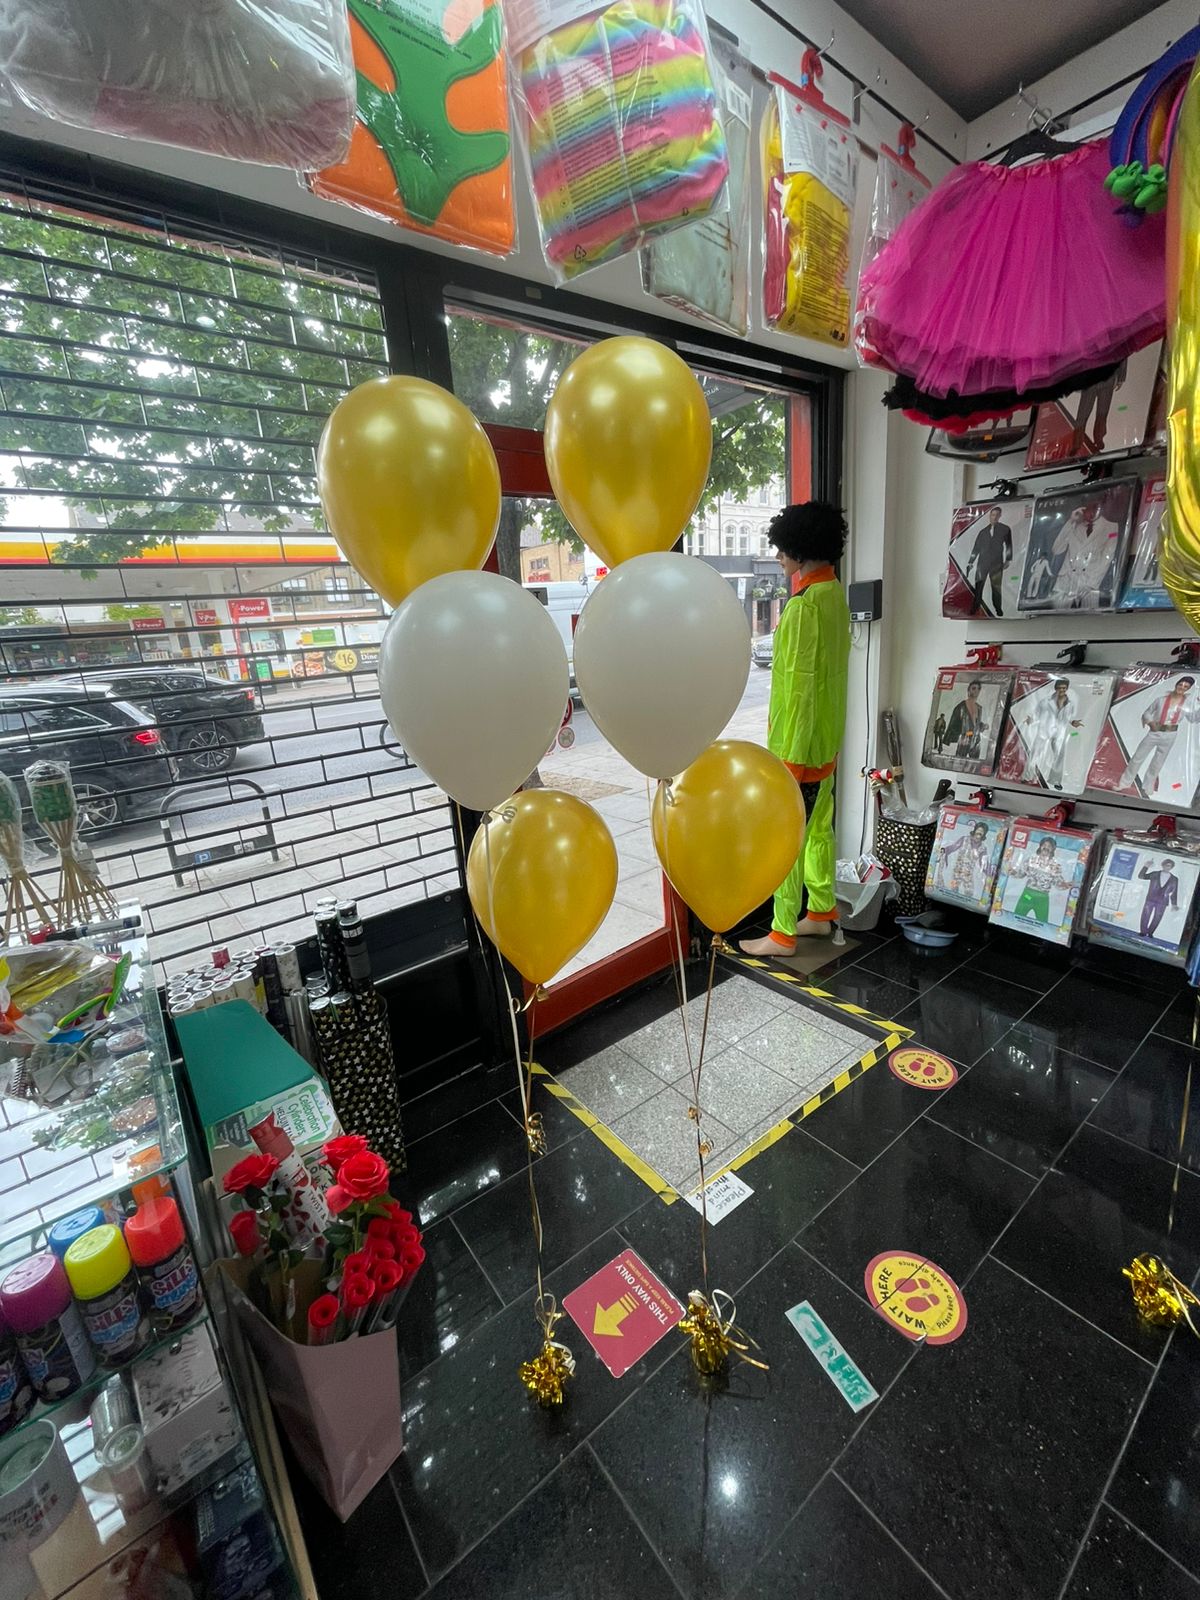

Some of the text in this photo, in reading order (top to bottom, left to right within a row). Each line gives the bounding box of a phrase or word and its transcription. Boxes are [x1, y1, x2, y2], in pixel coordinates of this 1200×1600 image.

[1038, 499, 1065, 508] FEVER
[921, 1076, 945, 1084] WAIT
[288, 1103, 307, 1135] Cylinders
[299, 1094, 321, 1133] Celebration
[307, 1191, 324, 1213] TWIST
[708, 1184, 731, 1205] mind
[716, 1186, 746, 1211] Please
[615, 1263, 669, 1325] THIS WAY ONLY
[878, 1267, 927, 1330] WAIT HERE
